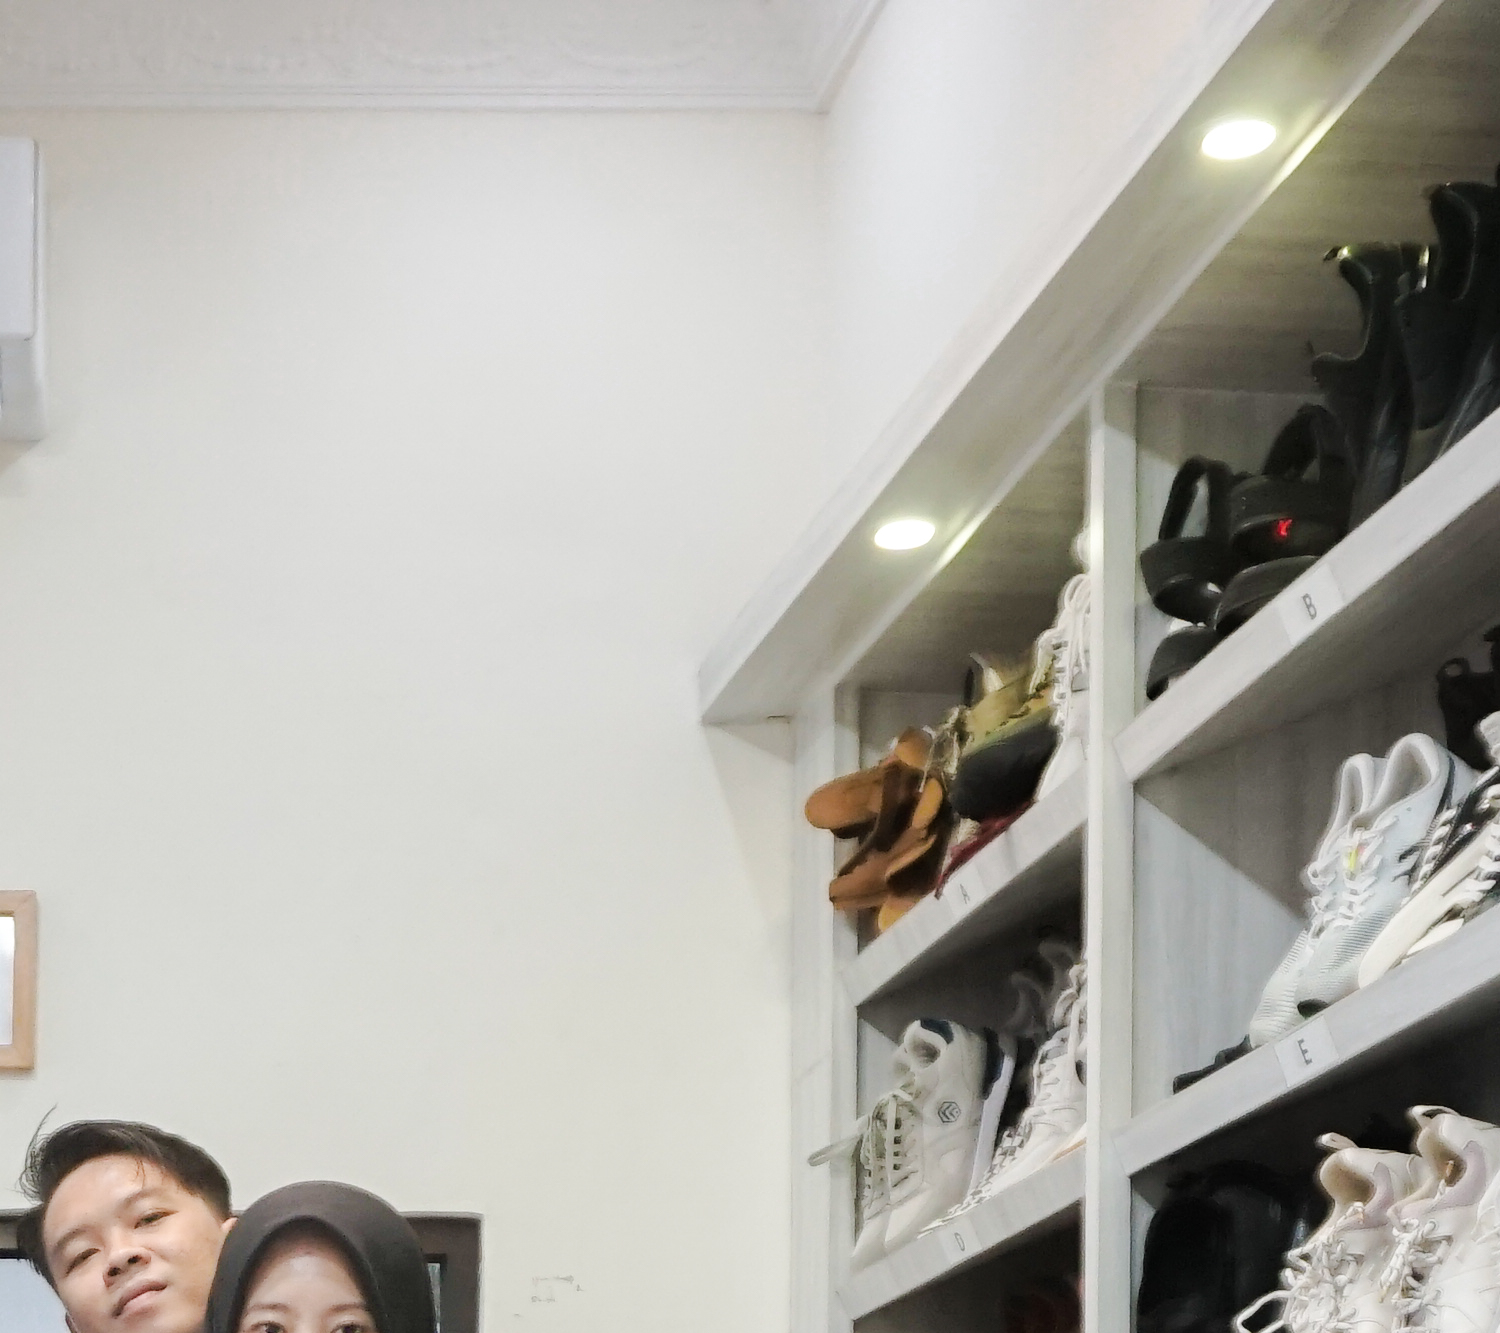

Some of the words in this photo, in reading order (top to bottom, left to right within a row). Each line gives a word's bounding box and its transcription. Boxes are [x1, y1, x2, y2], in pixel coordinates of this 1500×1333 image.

[1302, 593, 1318, 620] B
[959, 883, 971, 905] A
[1297, 1039, 1312, 1065] E
